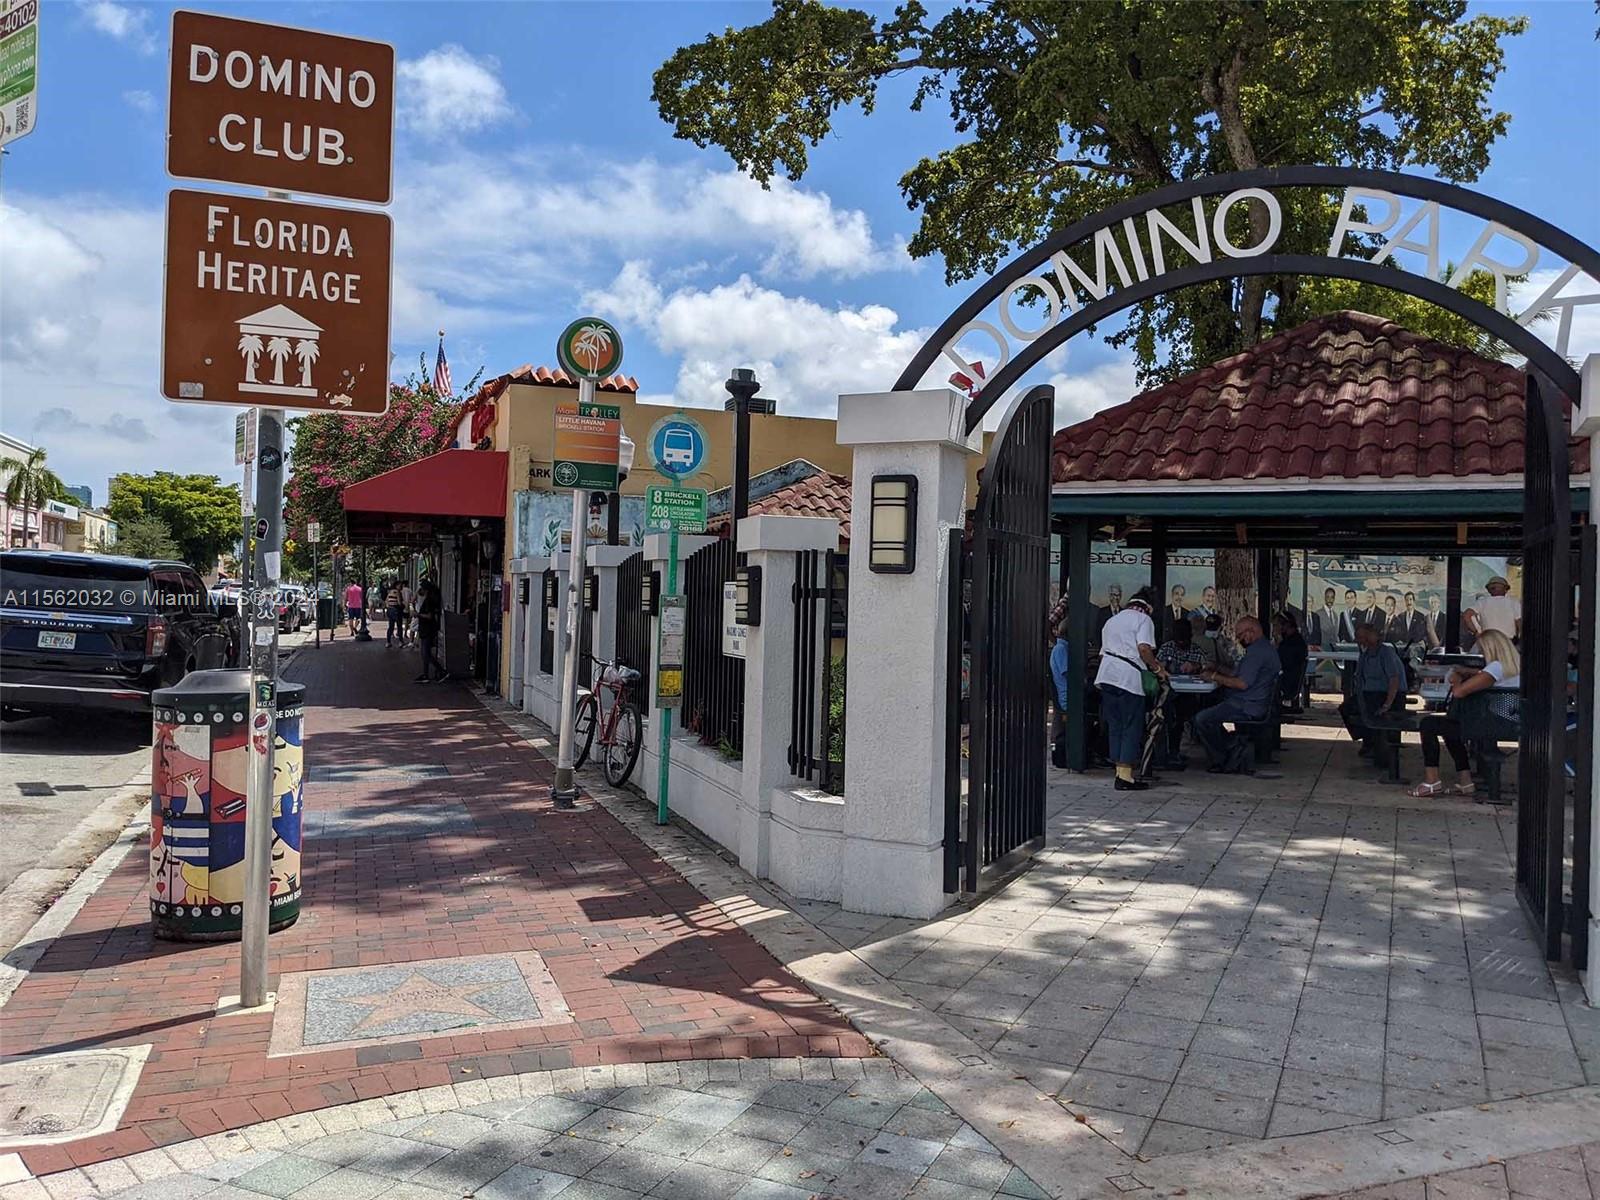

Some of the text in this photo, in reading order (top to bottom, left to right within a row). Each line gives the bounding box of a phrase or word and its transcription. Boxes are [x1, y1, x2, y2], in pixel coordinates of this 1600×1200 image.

[4, 1, 36, 33] 40102
[190, 44, 376, 109] DOMINO
[218, 113, 346, 166] CLUB
[207, 205, 354, 258] FLORIDA
[197, 250, 361, 304] HERITAGE
[942, 187, 1600, 384] DOMINO PARK
[559, 416, 606, 426] LITTLE HAVANA
[653, 490, 701, 504] 8 BRICKELL
[664, 497, 695, 506] STATION
[651, 504, 669, 518] 208
[1325, 558, 1435, 575] Americas
[23, 619, 94, 629] SUBURBAN
[284, 709, 295, 718] DO
[273, 893, 294, 907] MIAMI
